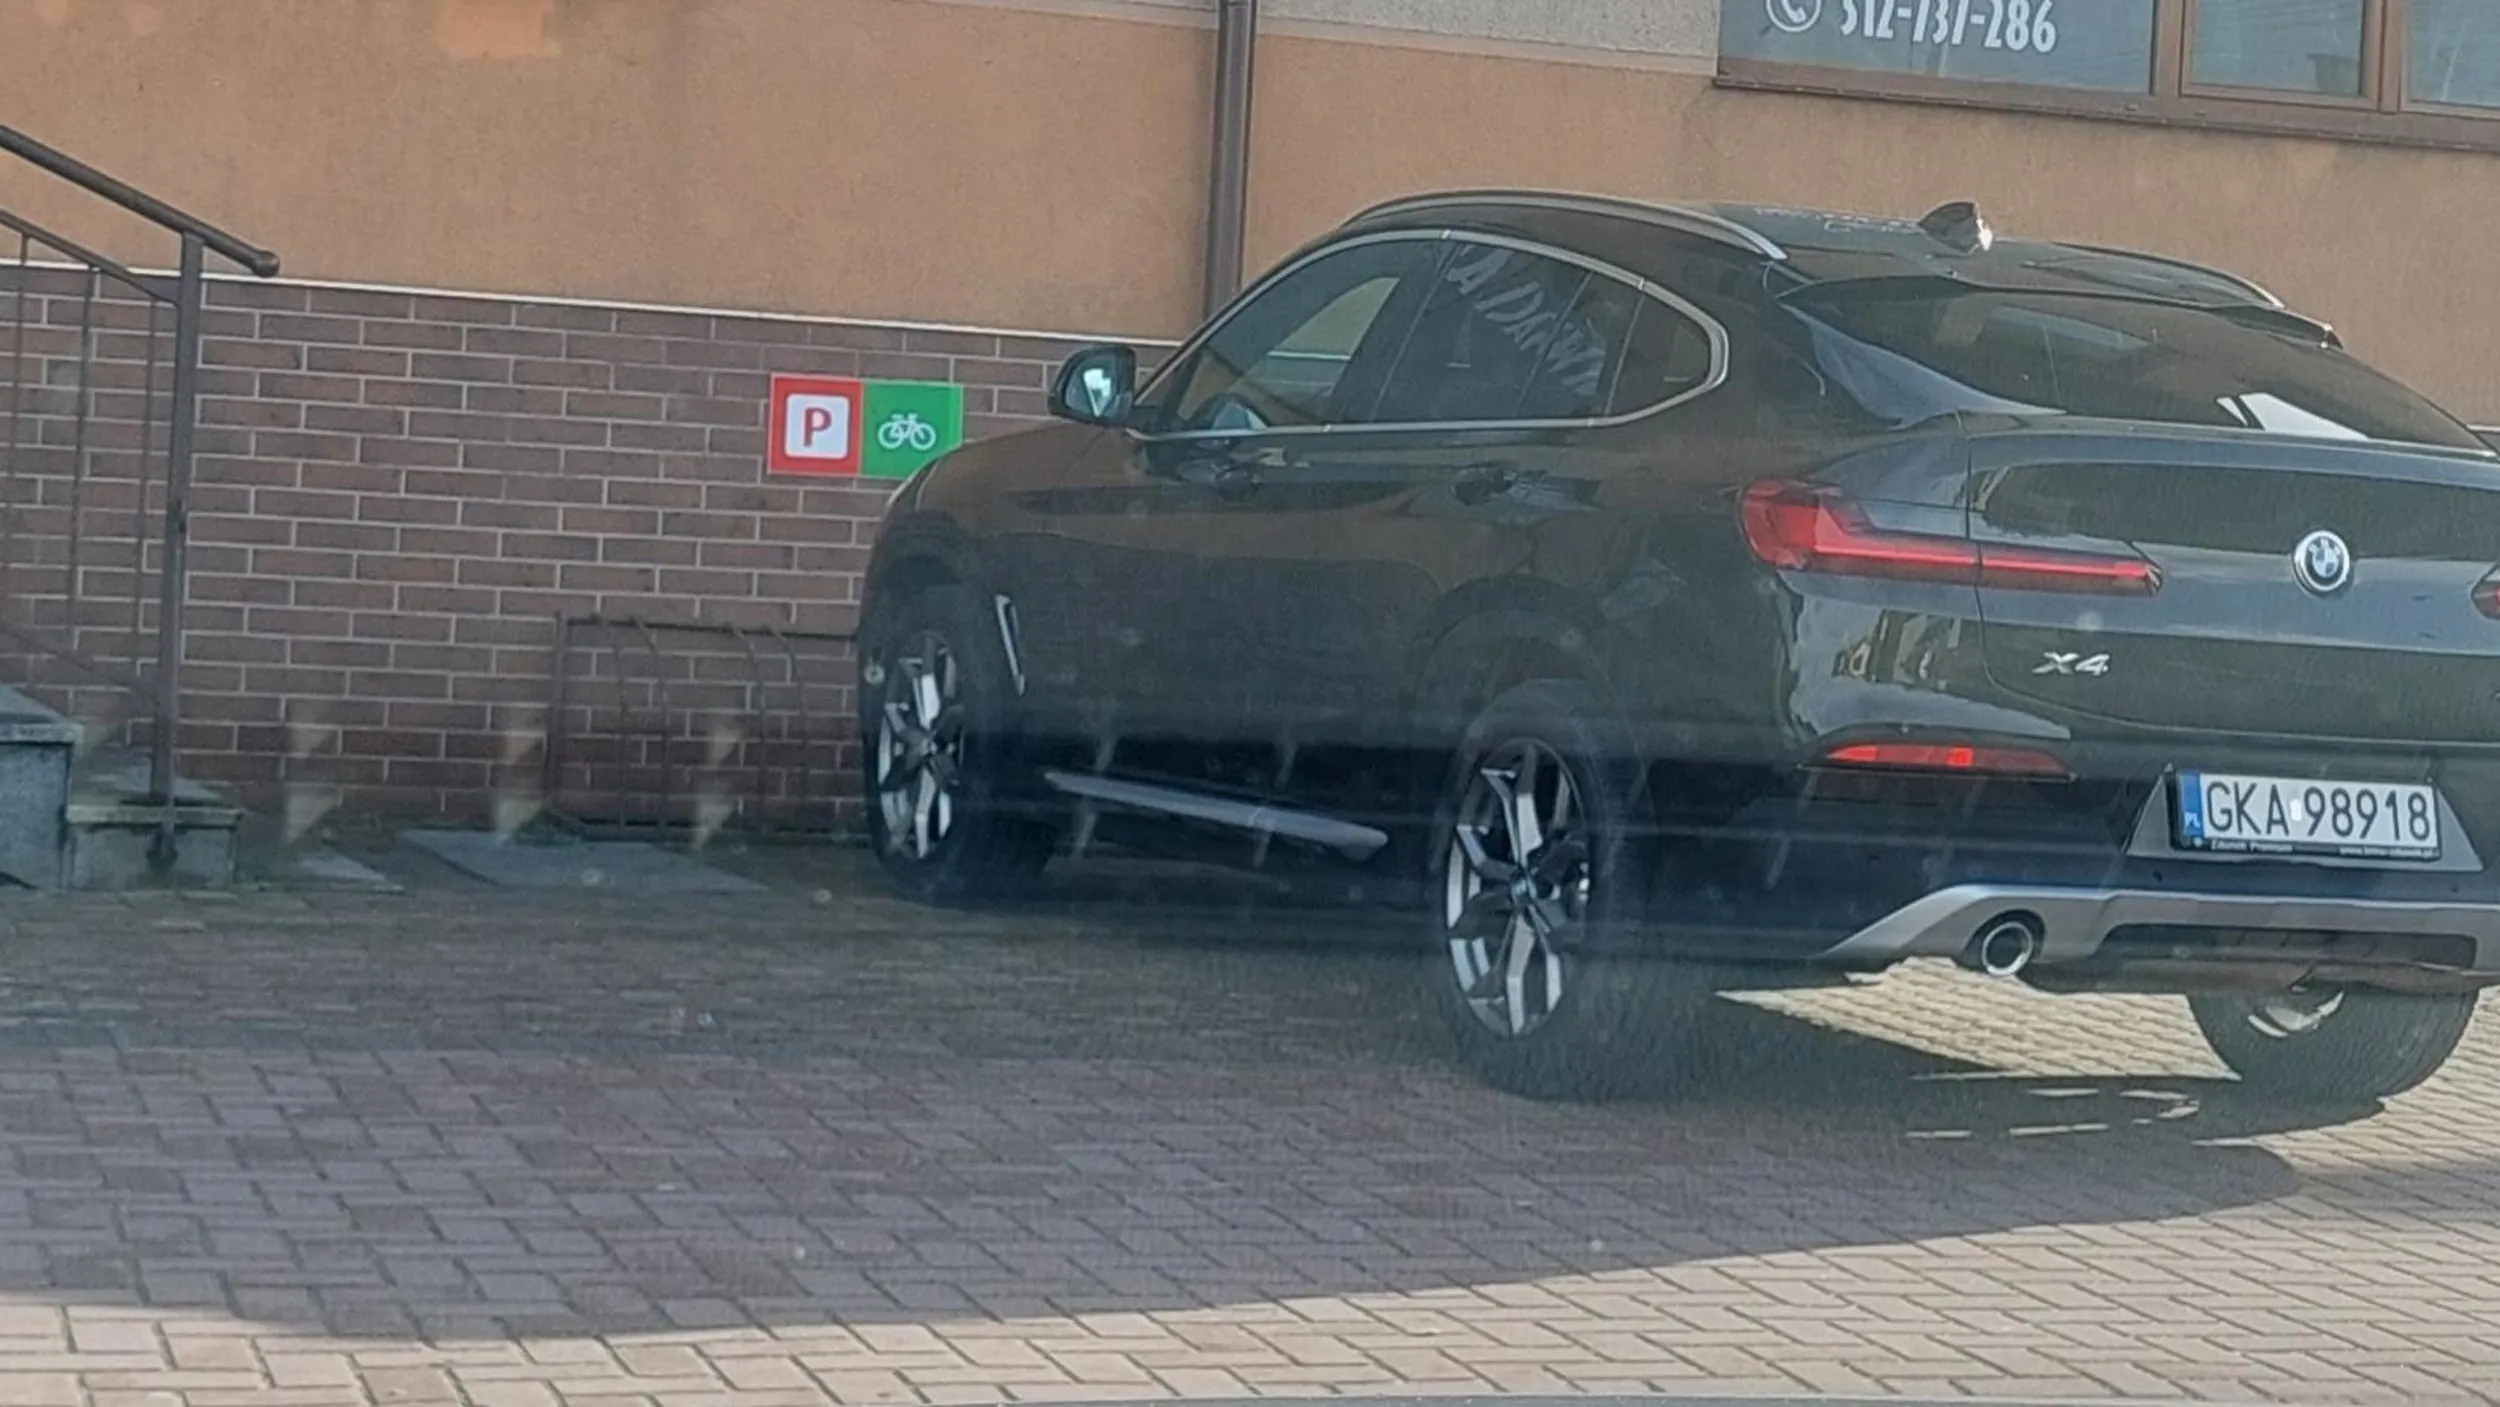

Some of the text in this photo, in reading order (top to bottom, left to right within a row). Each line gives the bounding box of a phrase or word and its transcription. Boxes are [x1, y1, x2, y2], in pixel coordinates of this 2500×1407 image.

[803, 407, 832, 448] P
[2032, 651, 2111, 676] X4
[2206, 780, 2431, 841] GKA 98918
